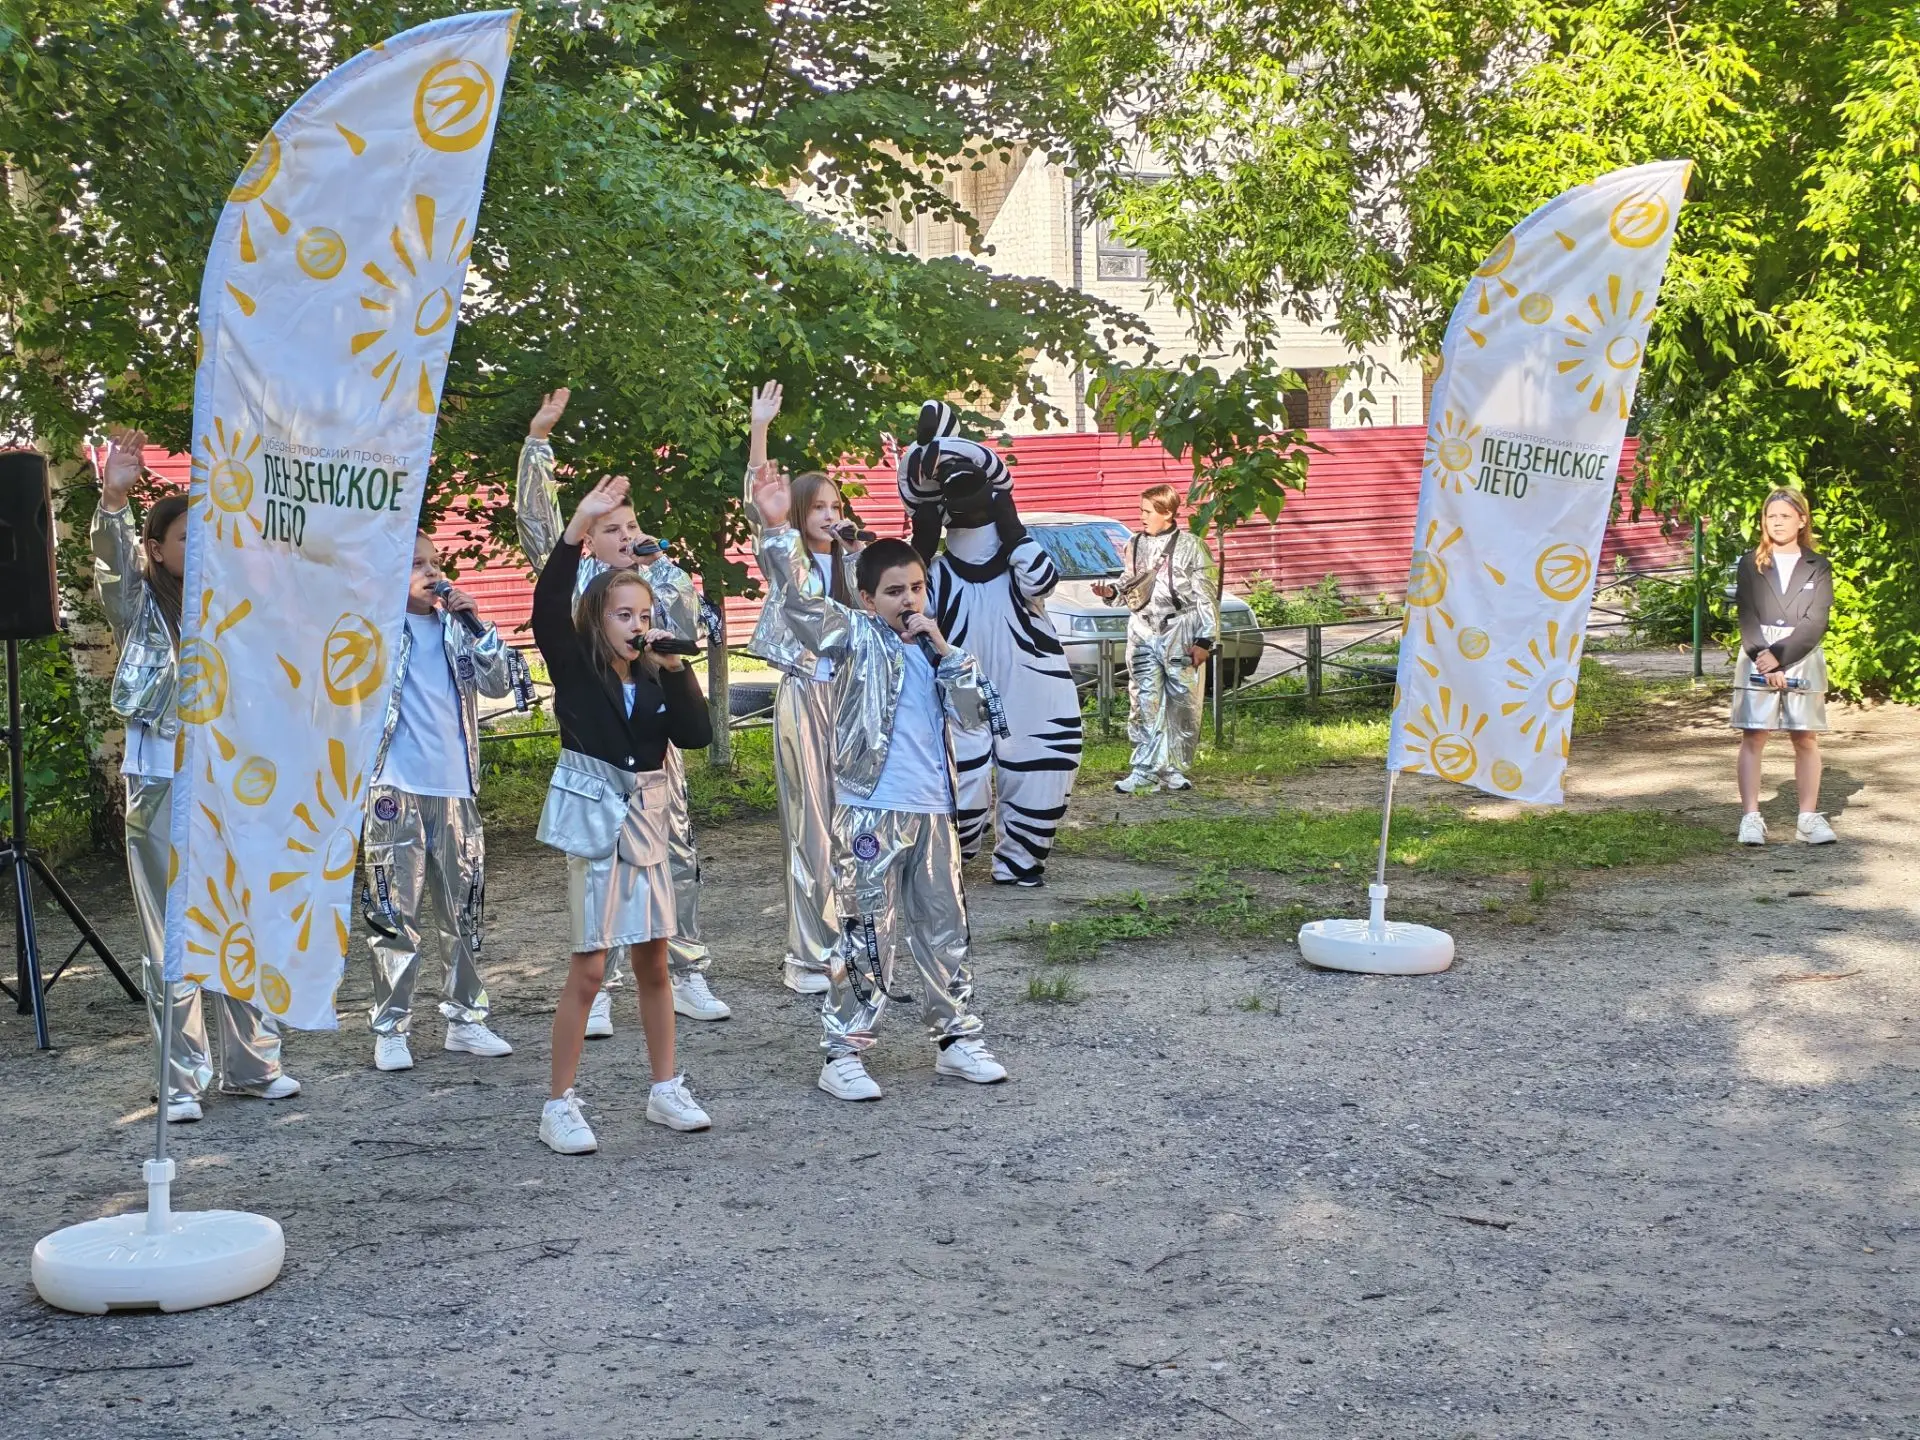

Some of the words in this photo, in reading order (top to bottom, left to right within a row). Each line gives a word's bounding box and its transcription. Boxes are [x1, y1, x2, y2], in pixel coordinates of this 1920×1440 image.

[353, 449, 410, 466] проект
[1481, 437, 1609, 480] ПЕНЗЕНСКОЕ
[264, 453, 409, 511] ПЕНЗЕНСКОЕ
[1474, 466, 1528, 499] ЛЕТО
